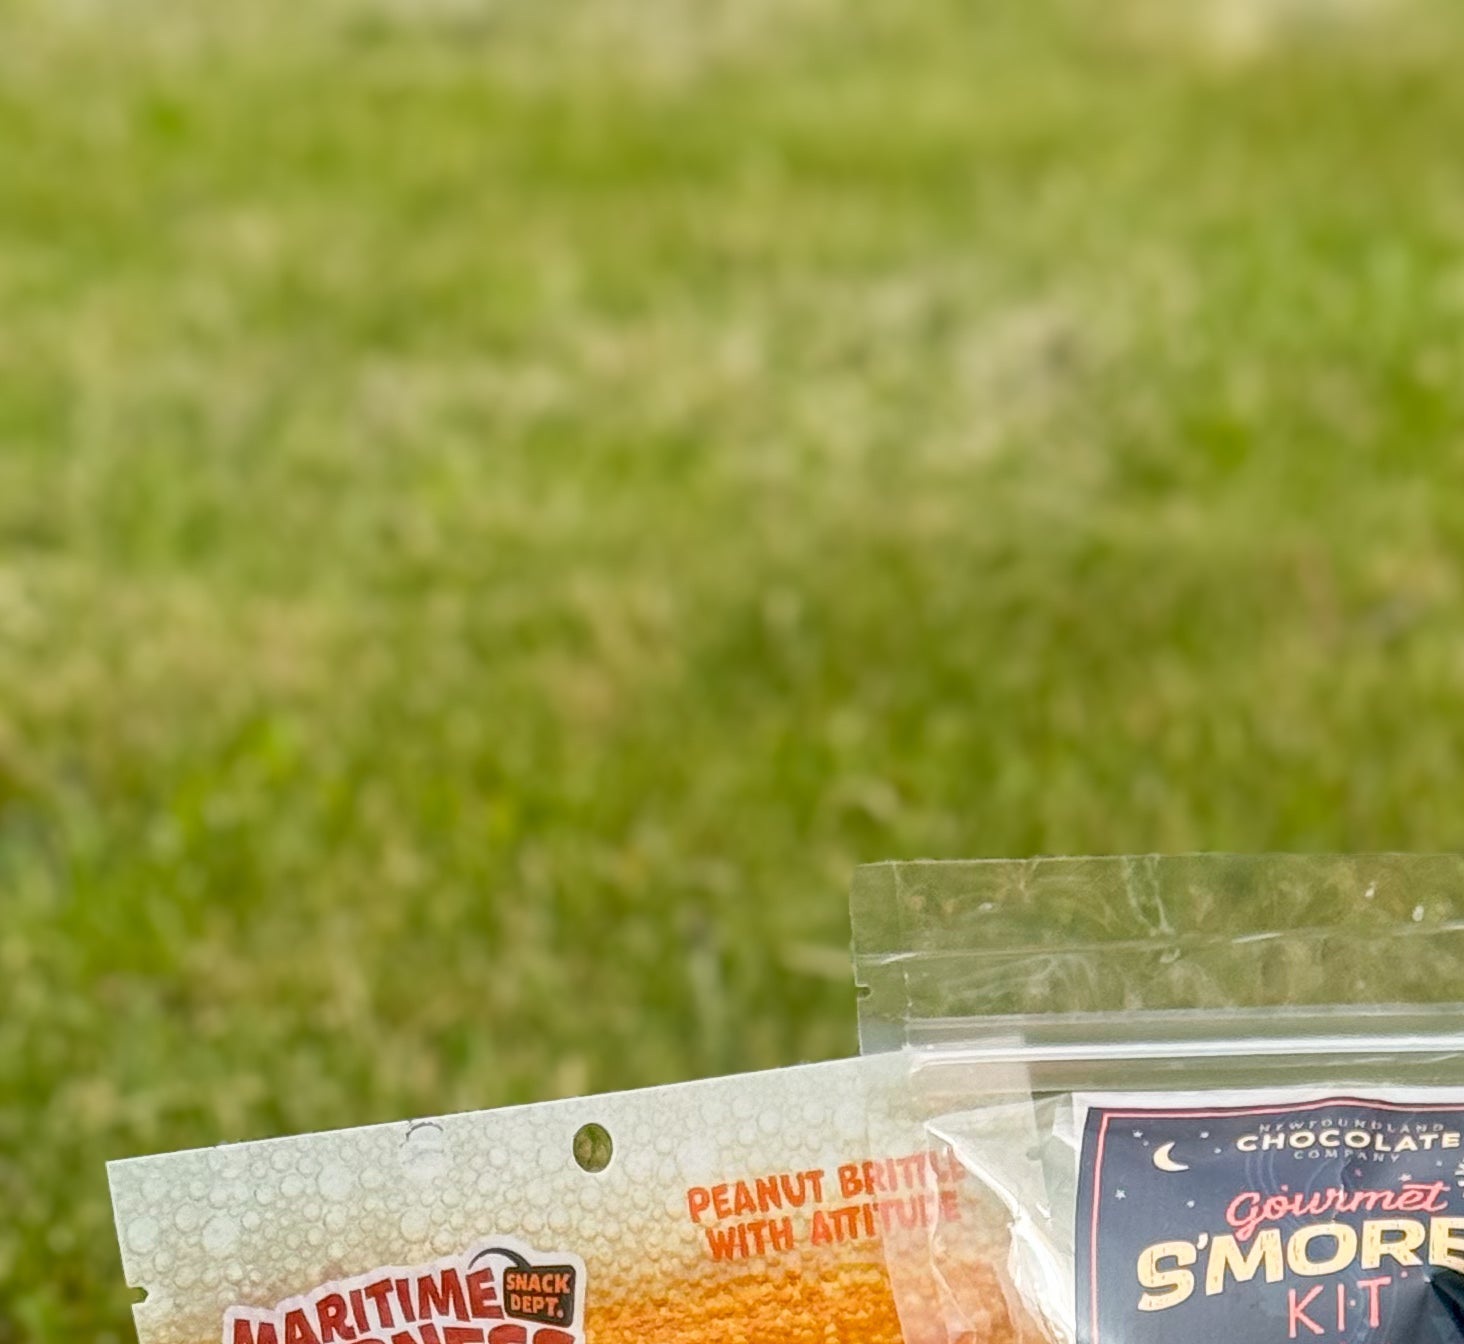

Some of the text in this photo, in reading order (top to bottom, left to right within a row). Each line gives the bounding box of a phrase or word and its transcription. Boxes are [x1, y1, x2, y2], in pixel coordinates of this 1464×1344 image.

[1258, 1117, 1445, 1134] NEWFOUNDLAND
[1236, 1129, 1462, 1153] CHOCOLATE
[1293, 1149, 1401, 1164] COMPANY
[687, 1147, 967, 1223] PEANUT BRITTLE
[1226, 1180, 1453, 1242] Gourmet
[705, 1190, 962, 1261] WITH ATTITUDE
[505, 1272, 571, 1294] SNACK
[510, 1295, 565, 1319] DEPT.
[1288, 1276, 1392, 1339] KIT
